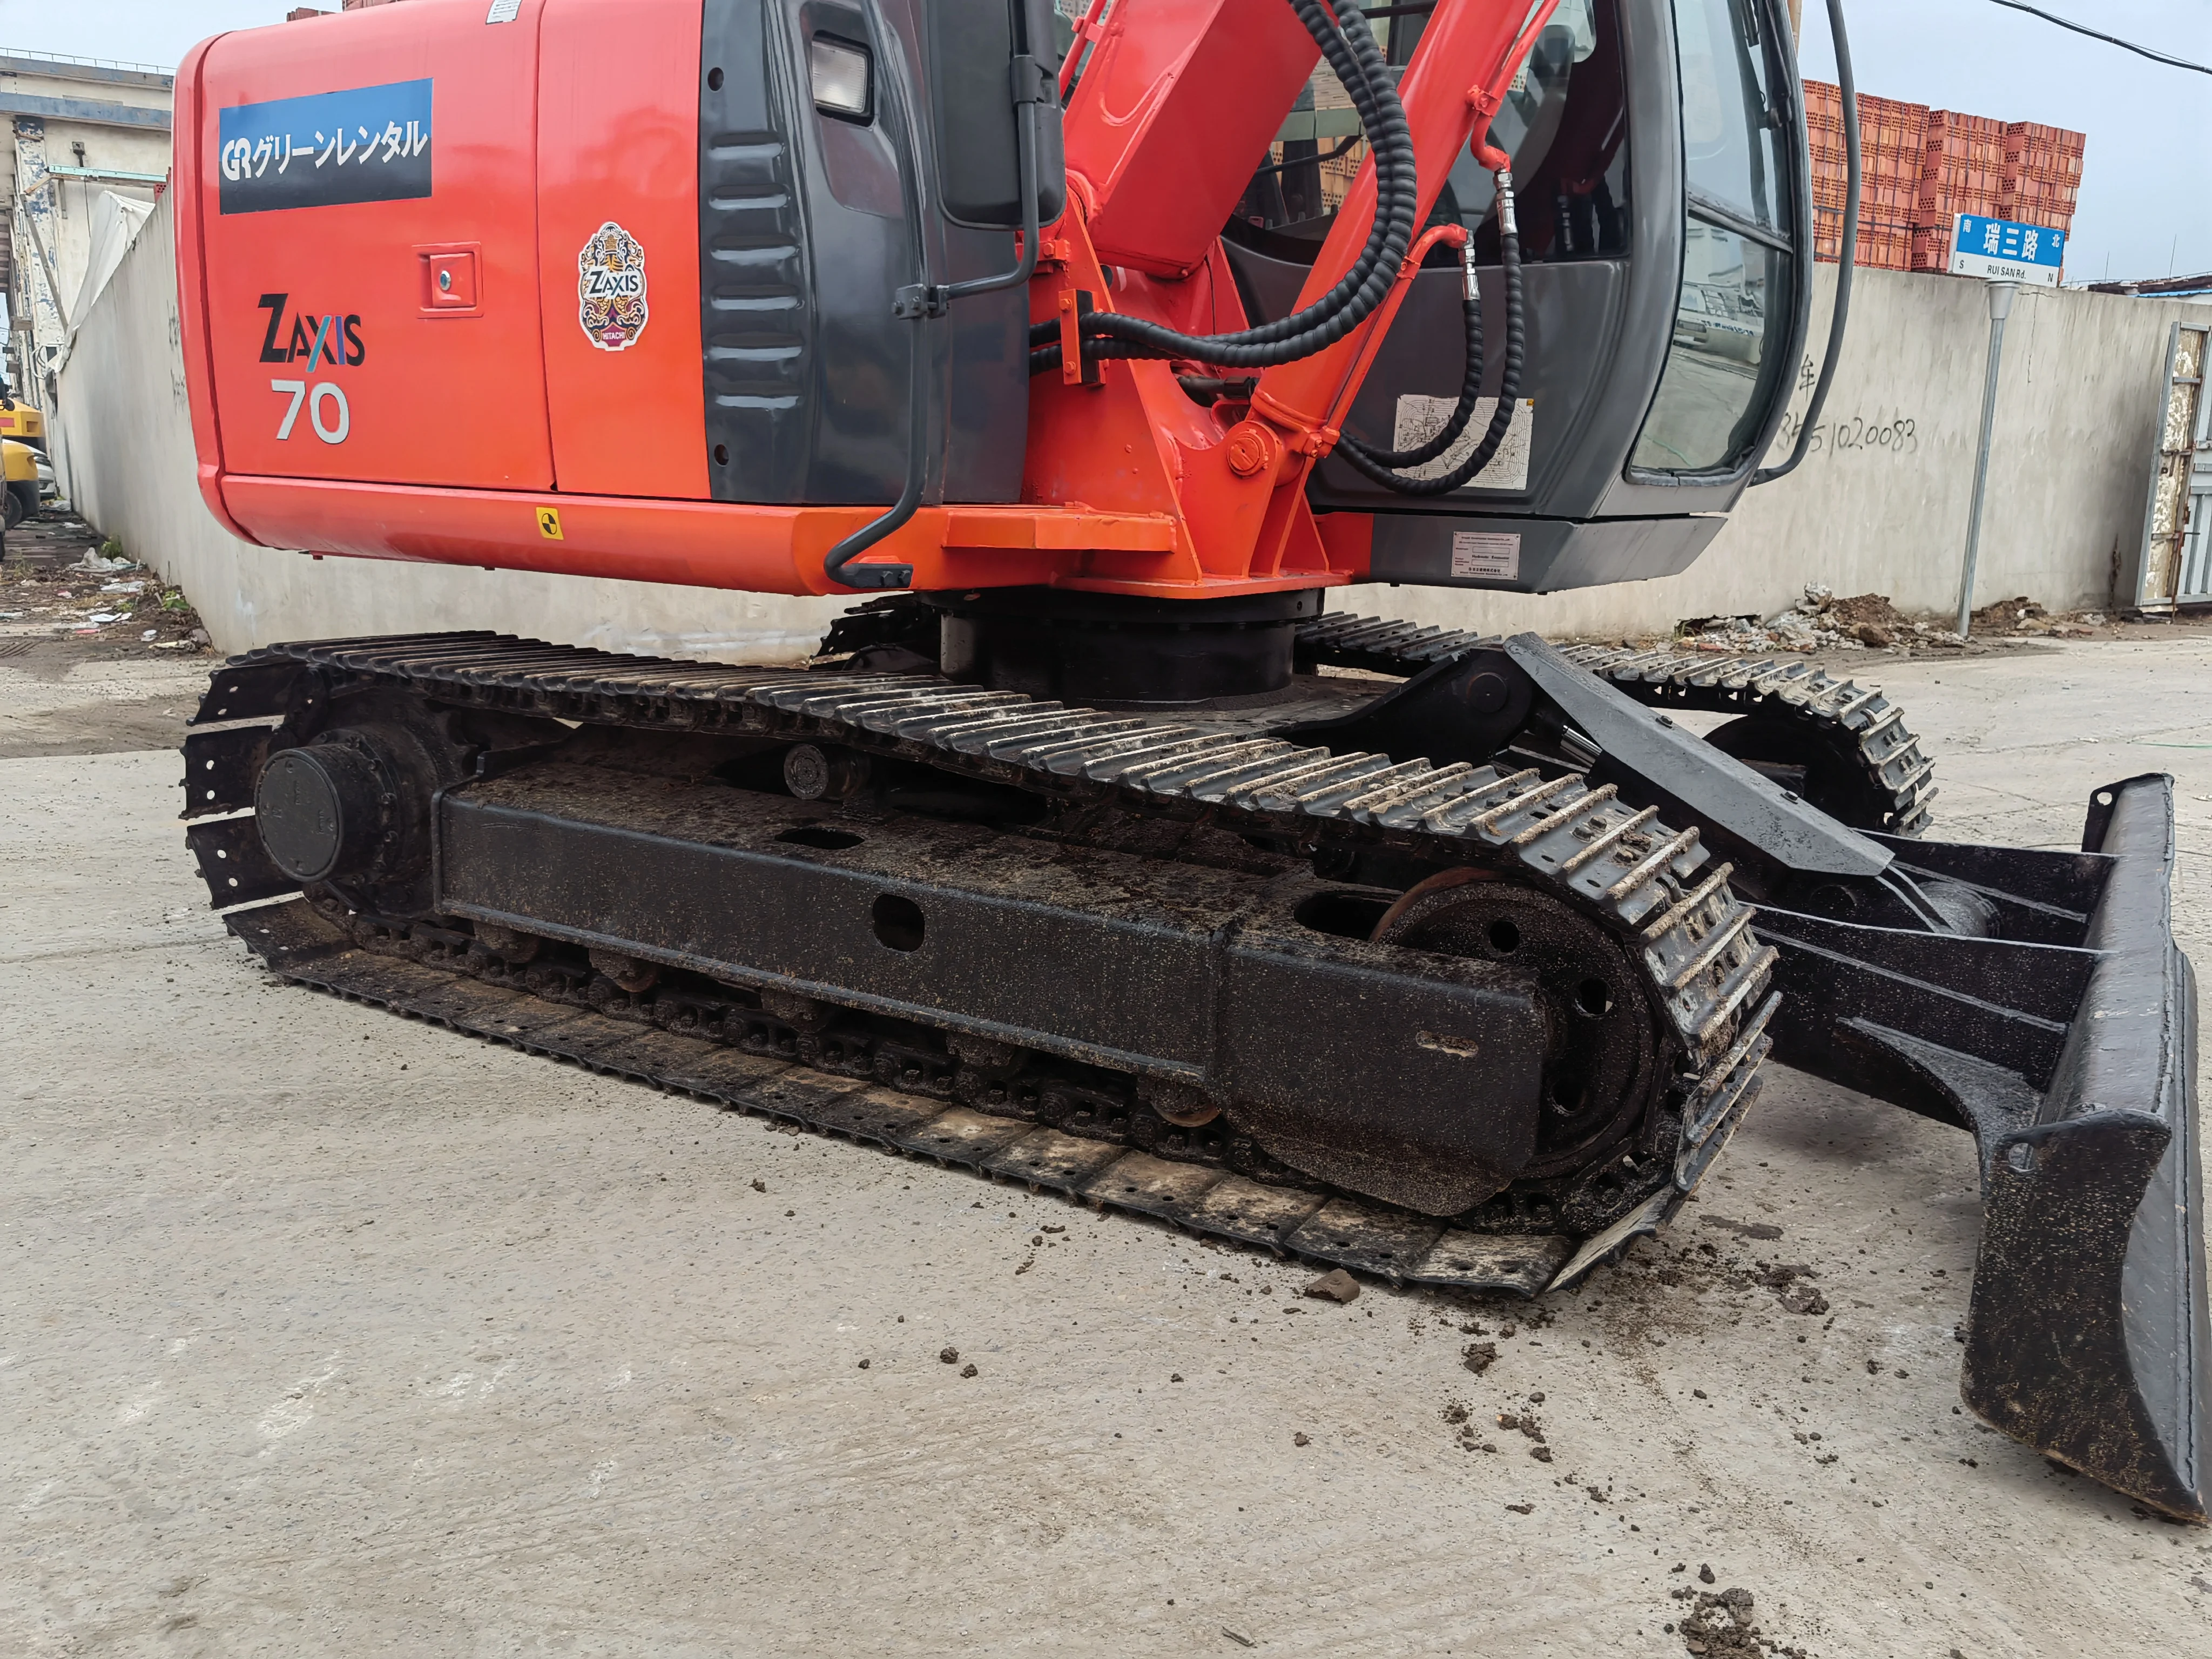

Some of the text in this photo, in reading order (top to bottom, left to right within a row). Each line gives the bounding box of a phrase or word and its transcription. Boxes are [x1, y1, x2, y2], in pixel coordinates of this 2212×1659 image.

[1963, 219, 1972, 233] 南
[1983, 222, 2039, 261] 瑞三路
[2052, 234, 2060, 247] 北
[1959, 259, 1964, 269] S
[1987, 265, 2026, 279] RUI SAN Rd.
[2048, 273, 2053, 282] N
[589, 271, 639, 296] ZAXIS
[258, 293, 365, 373] ZAXIS
[603, 332, 625, 340] HITACHI
[271, 379, 350, 444] 70
